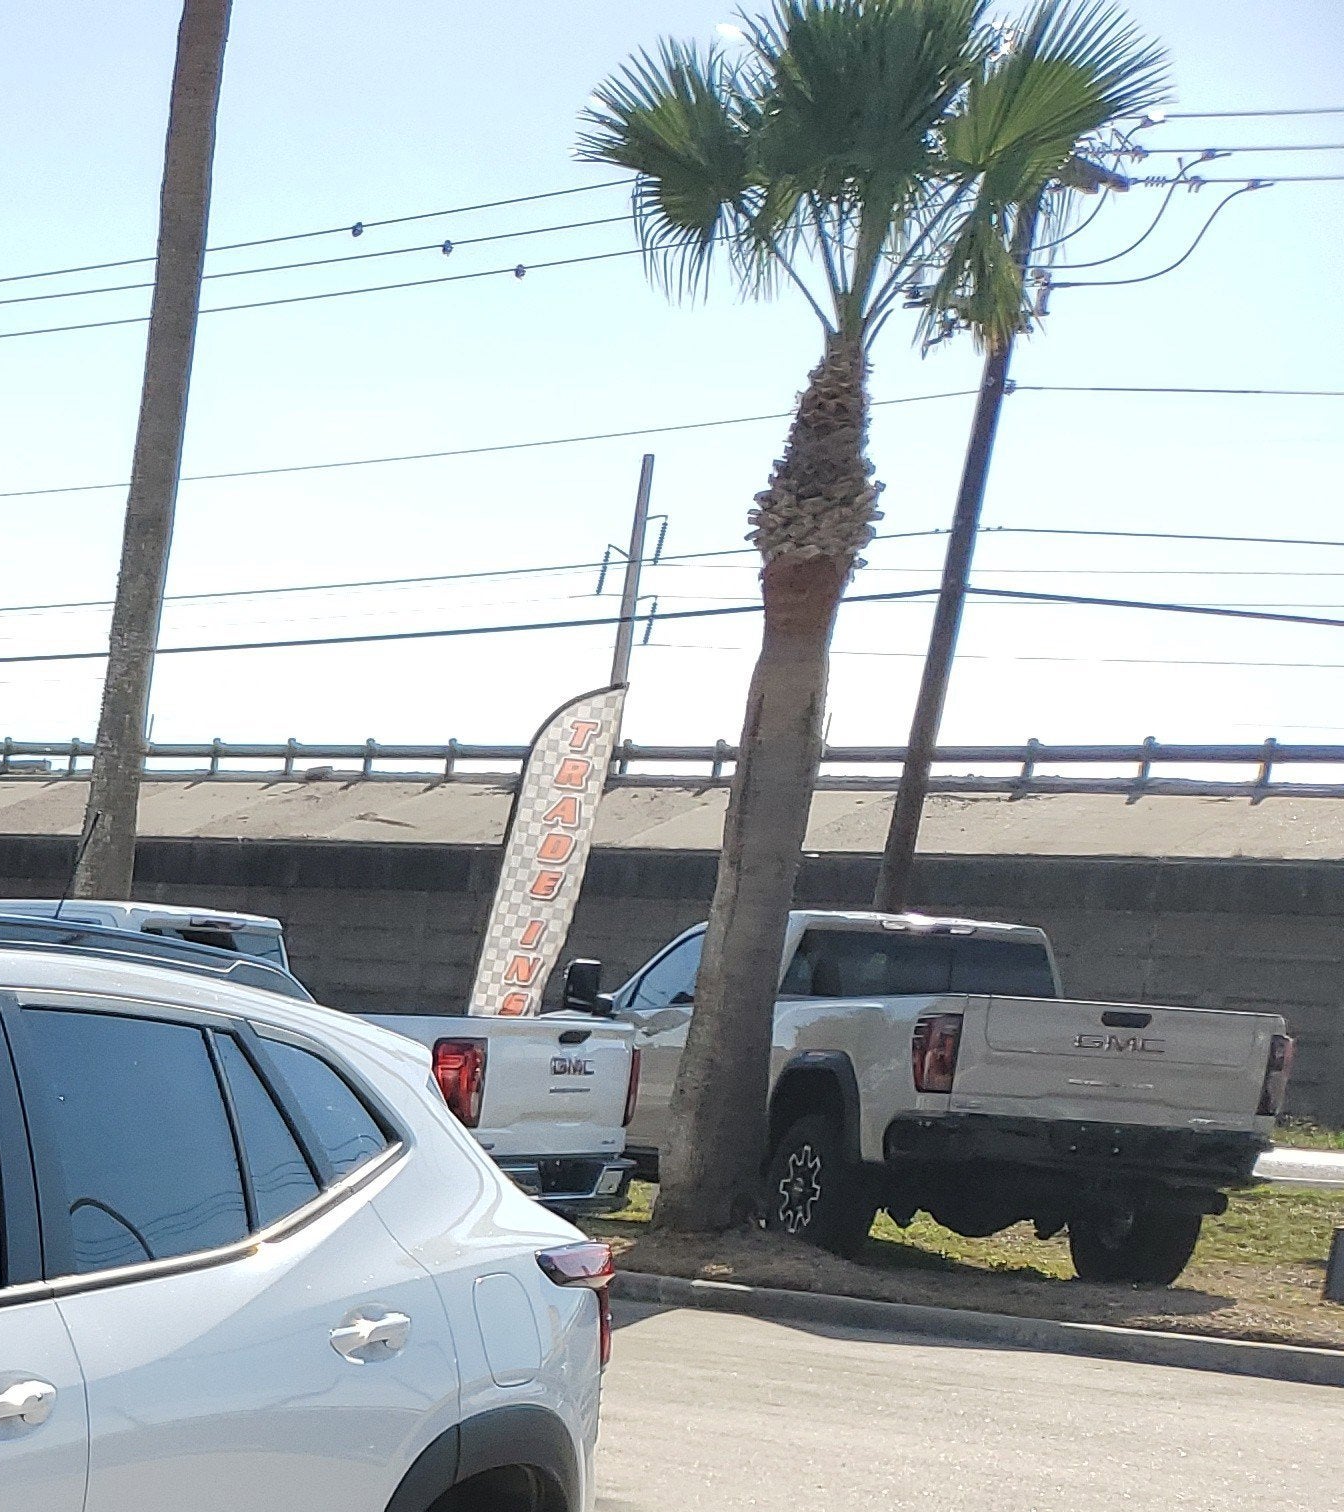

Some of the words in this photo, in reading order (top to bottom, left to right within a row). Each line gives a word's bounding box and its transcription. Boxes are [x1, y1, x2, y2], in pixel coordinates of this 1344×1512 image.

[529, 719, 601, 901] TRADE
[1072, 1033, 1166, 1054] GMC
[550, 1057, 595, 1075] GMC
